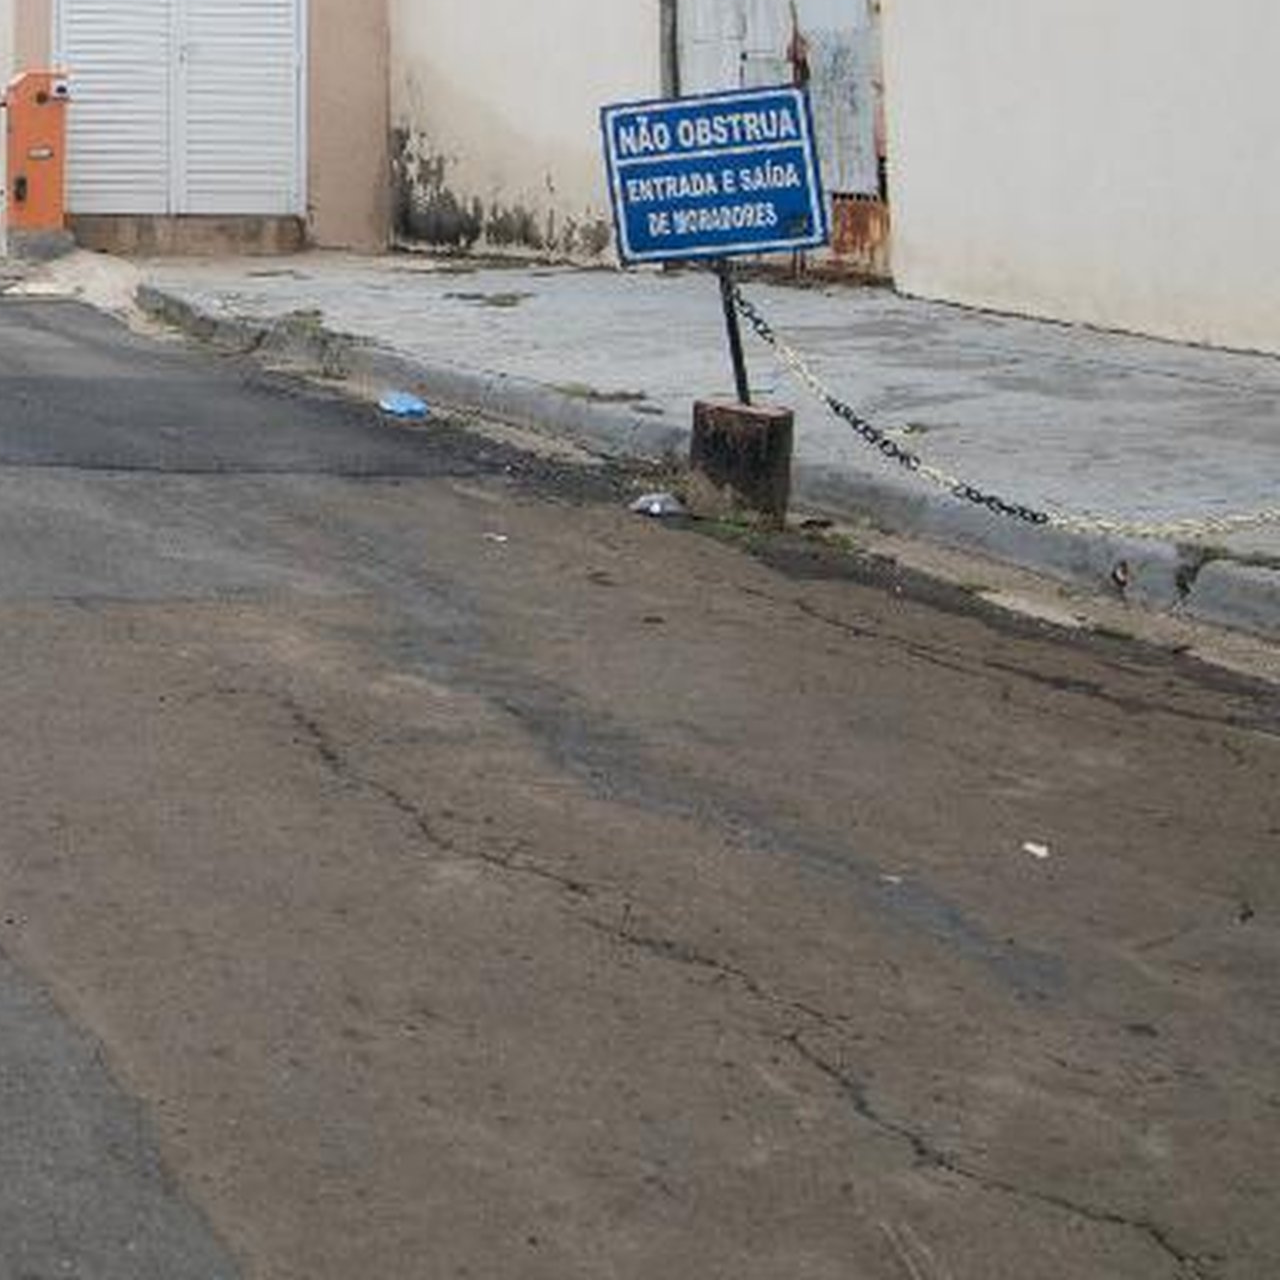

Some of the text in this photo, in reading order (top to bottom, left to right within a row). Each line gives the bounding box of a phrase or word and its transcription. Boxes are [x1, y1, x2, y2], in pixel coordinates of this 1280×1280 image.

[618, 108, 797, 156] NÃO OBSTRUA
[626, 158, 801, 203] ENTRADA E SAÍDA
[648, 202, 779, 237] DE MORADORES
